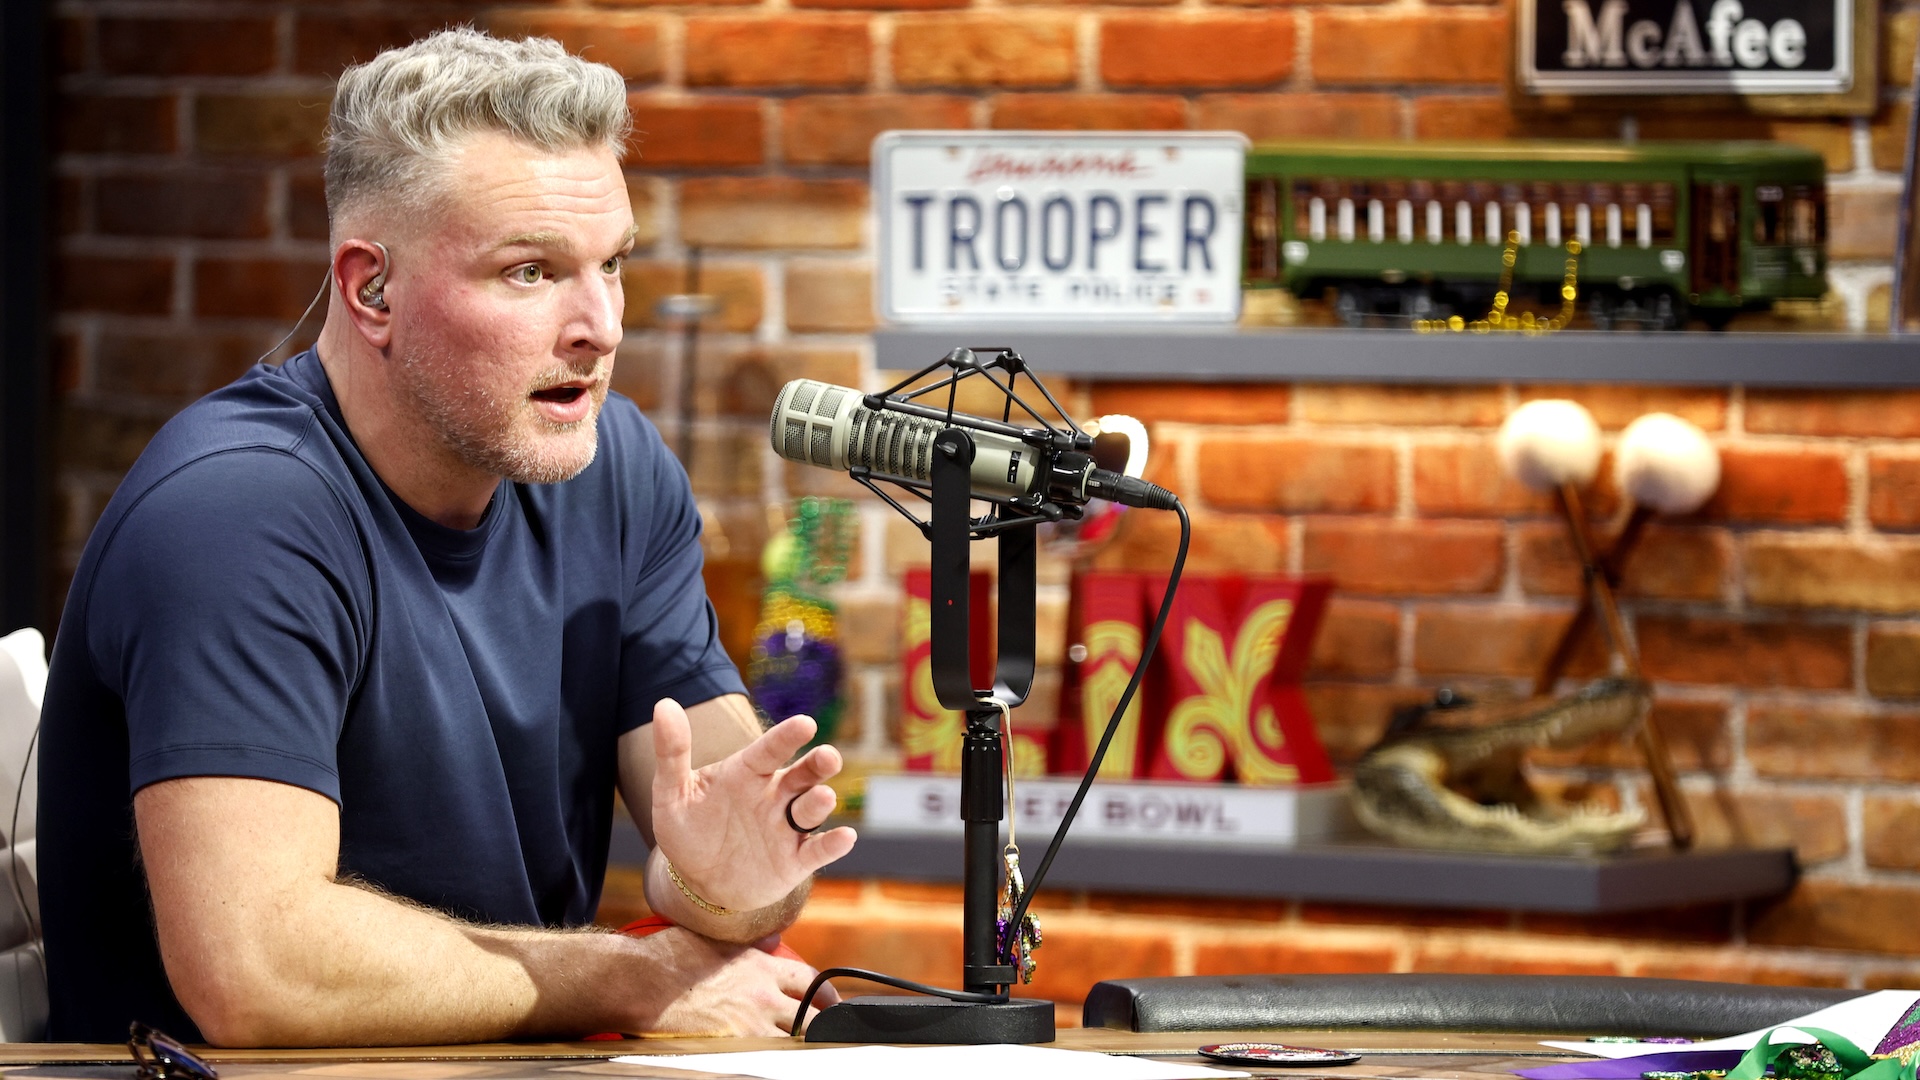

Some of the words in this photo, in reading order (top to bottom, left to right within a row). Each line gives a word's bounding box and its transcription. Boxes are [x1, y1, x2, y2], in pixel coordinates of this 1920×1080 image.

[1561, 0, 1807, 68] McAfee
[904, 192, 1219, 273] TROOPER
[921, 789, 1083, 820] SER
[1102, 797, 1238, 832] BOWL
